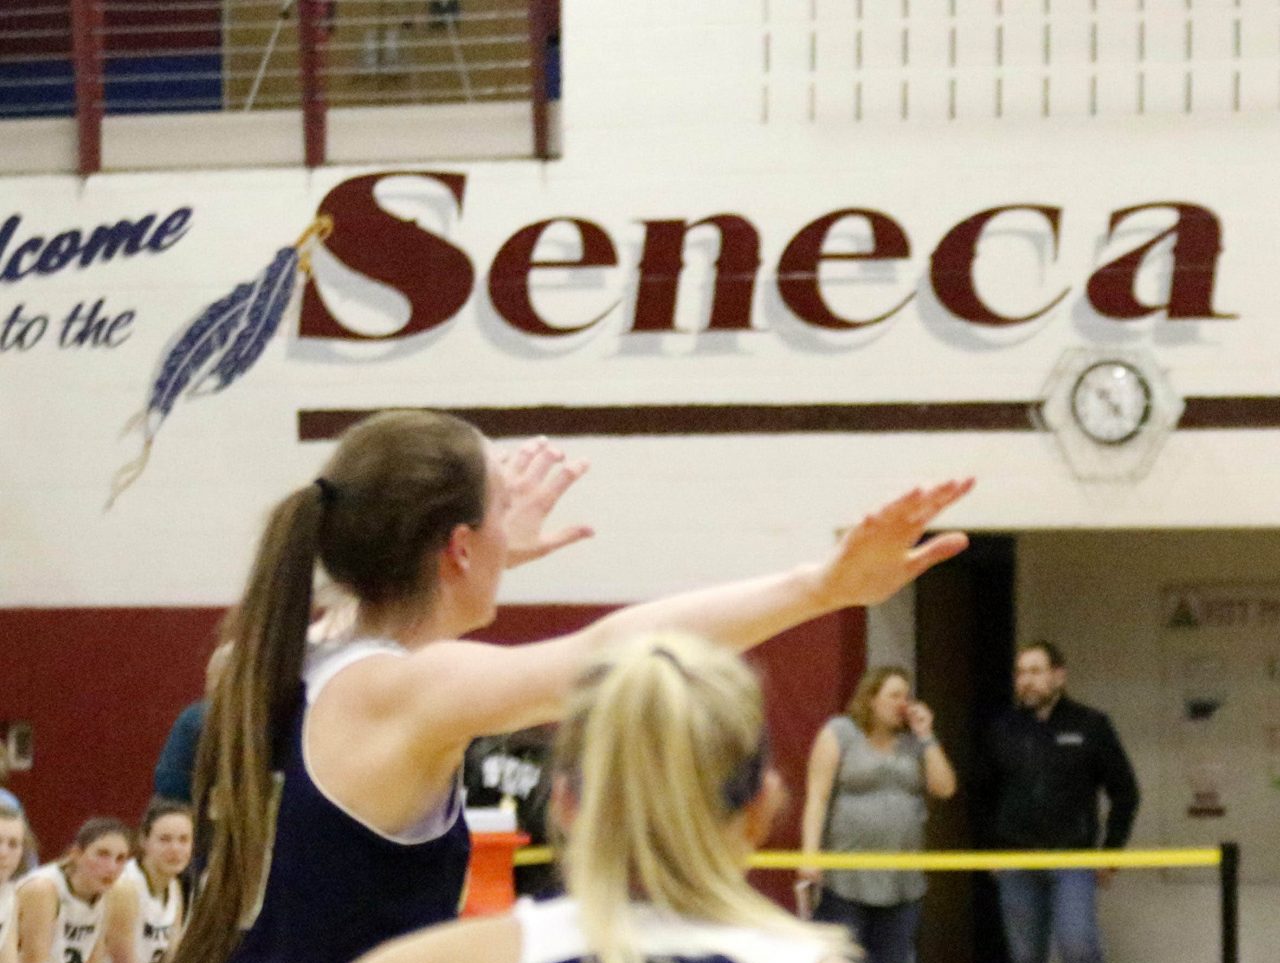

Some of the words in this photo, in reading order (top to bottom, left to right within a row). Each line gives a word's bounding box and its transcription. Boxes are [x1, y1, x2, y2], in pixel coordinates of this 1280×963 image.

[296, 170, 1240, 342] Seneca
[0, 303, 49, 351] to
[59, 296, 136, 349] the
